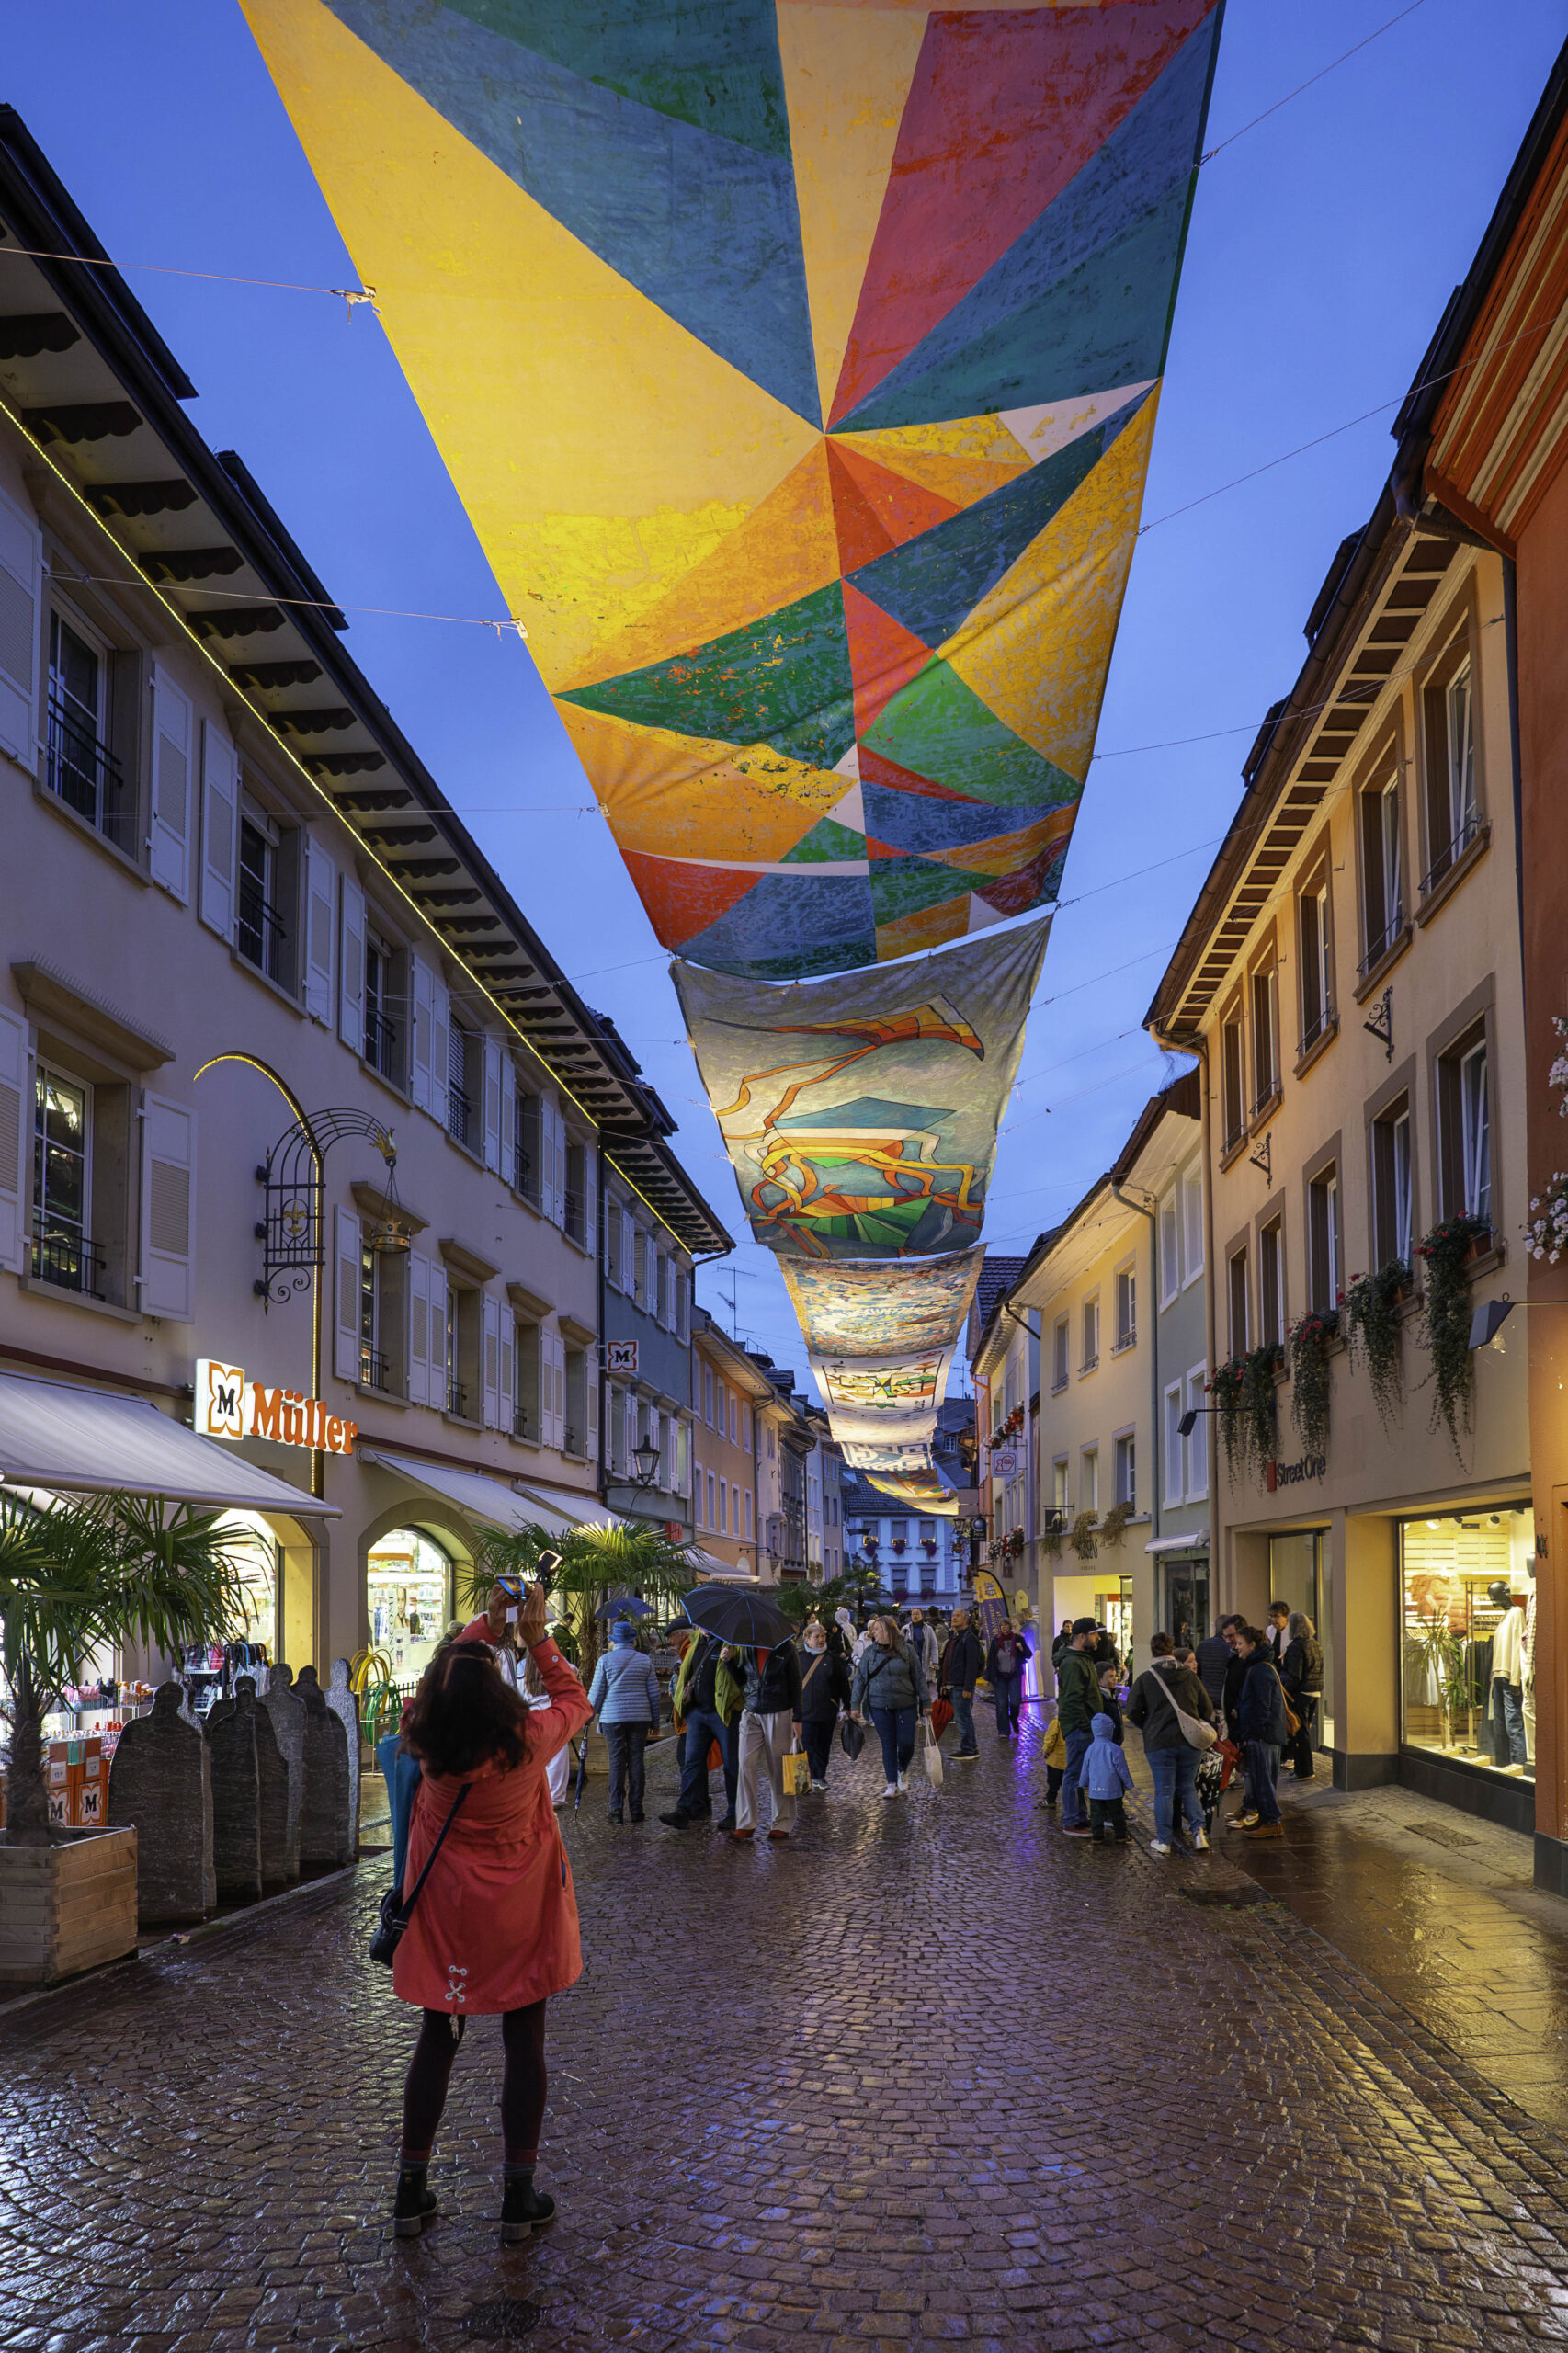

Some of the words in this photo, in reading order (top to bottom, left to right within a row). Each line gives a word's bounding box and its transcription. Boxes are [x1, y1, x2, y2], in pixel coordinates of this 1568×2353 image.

[615, 1349, 630, 1363] M
[217, 1384, 235, 1417] M
[250, 1381, 358, 1455] Müller
[1277, 1457, 1305, 1487] Street
[51, 1801, 63, 1820] M
[85, 1793, 97, 1814] M
